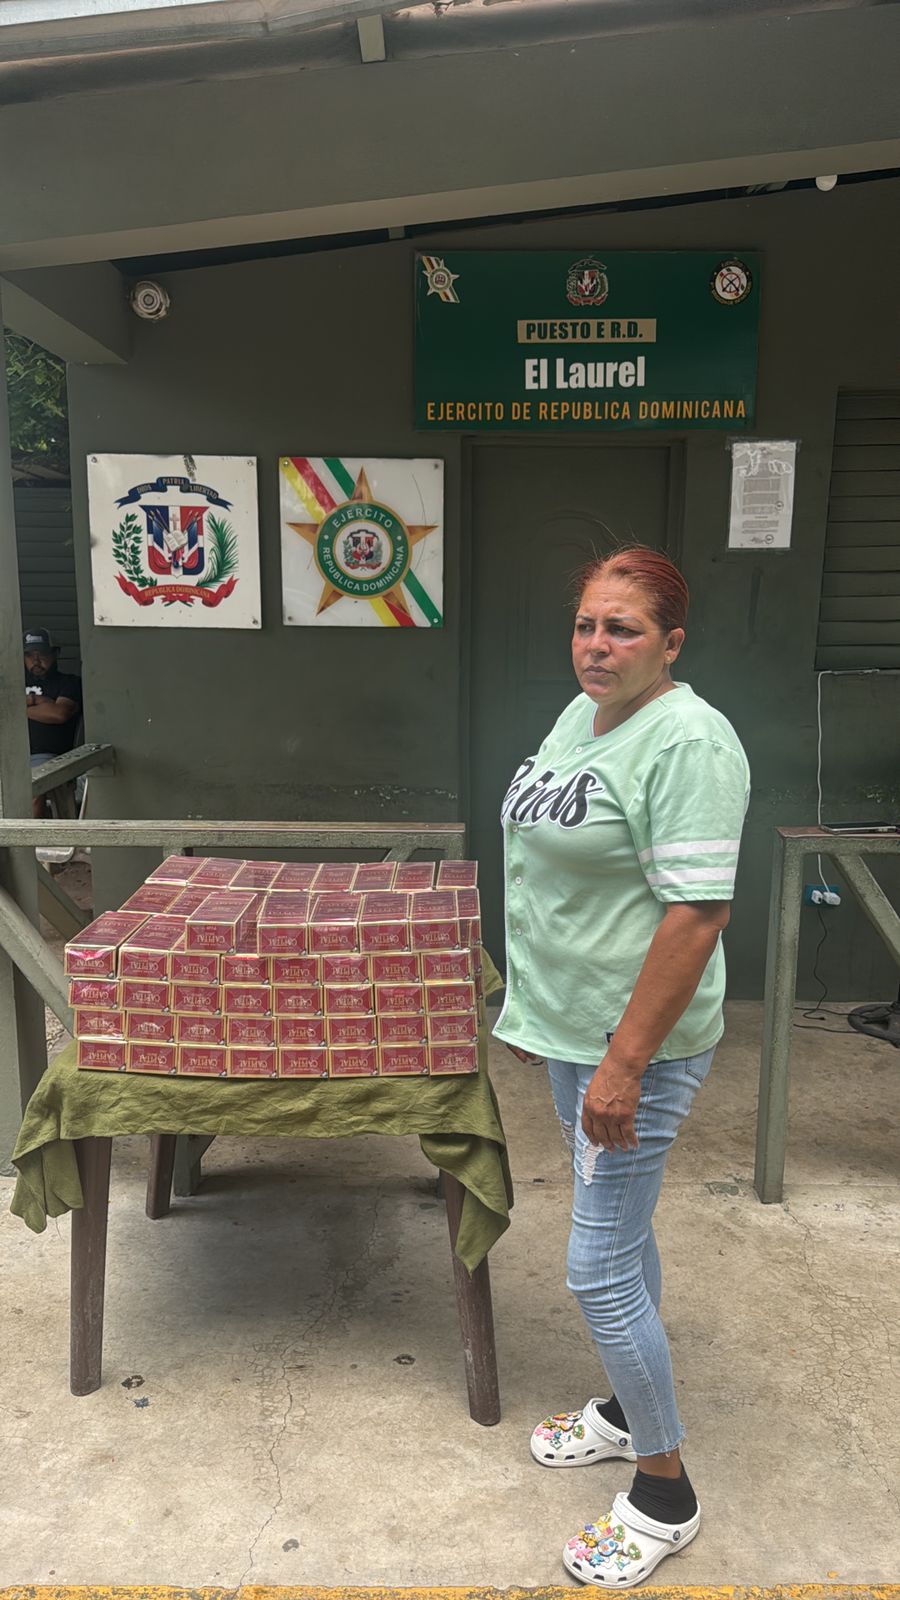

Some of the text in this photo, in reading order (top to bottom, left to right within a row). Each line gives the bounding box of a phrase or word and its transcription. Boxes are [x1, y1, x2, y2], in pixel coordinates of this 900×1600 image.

[526, 321, 643, 339] PUESTO E R.D.
[525, 356, 645, 389] El Laurel
[427, 400, 746, 421] EJERCITO DE REPUBLICA DOMINICANA
[332, 508, 393, 528] EJERCITO
[323, 546, 360, 591] REPUBLICA
[362, 545, 404, 592] DOMINICANA
